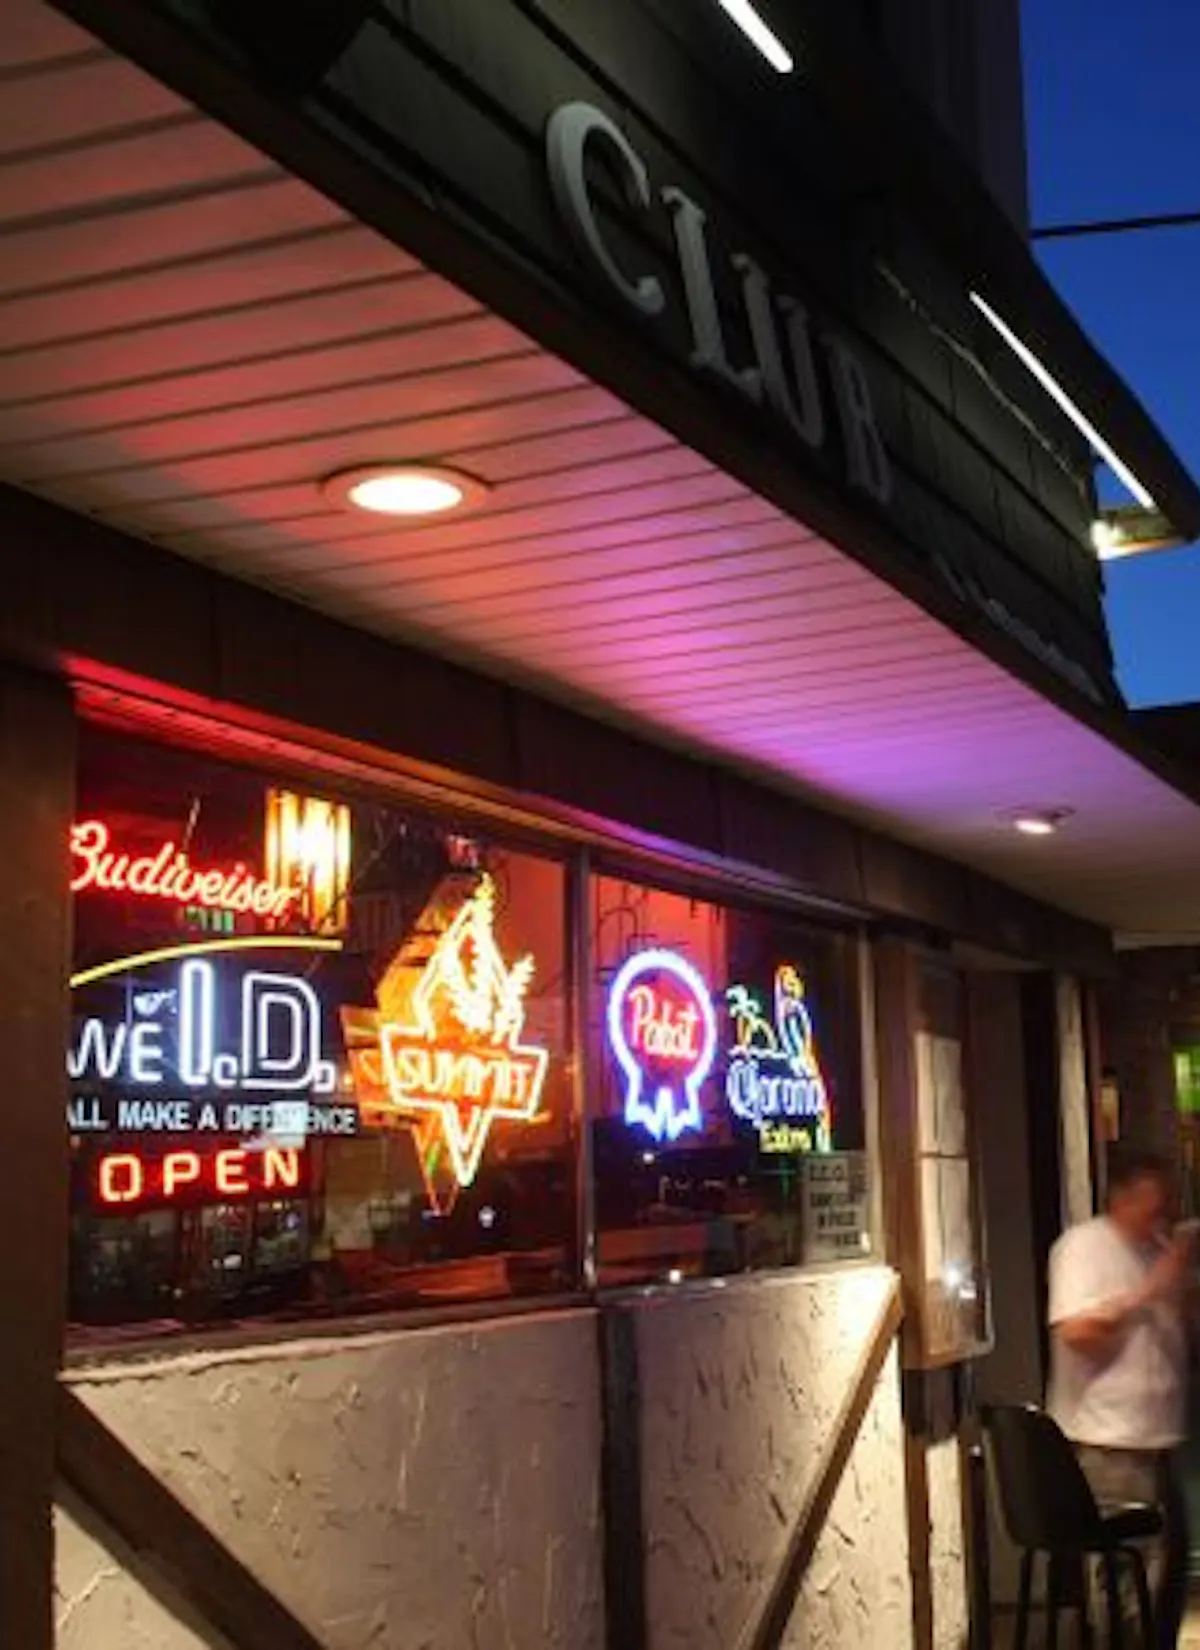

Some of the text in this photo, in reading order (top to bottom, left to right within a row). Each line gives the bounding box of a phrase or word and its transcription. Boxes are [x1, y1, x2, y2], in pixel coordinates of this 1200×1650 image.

[547, 101, 893, 504] CLUB
[69, 820, 302, 917] Budweiser
[629, 985, 699, 1059] Pabst
[396, 1048, 533, 1104] SUMMIT
[726, 1059, 826, 1129] Corona
[118, 1101, 191, 1131] MAKE
[198, 1102, 219, 1131] A
[225, 1104, 356, 1135] DIFFENCE
[101, 1147, 300, 1202] OPEN
